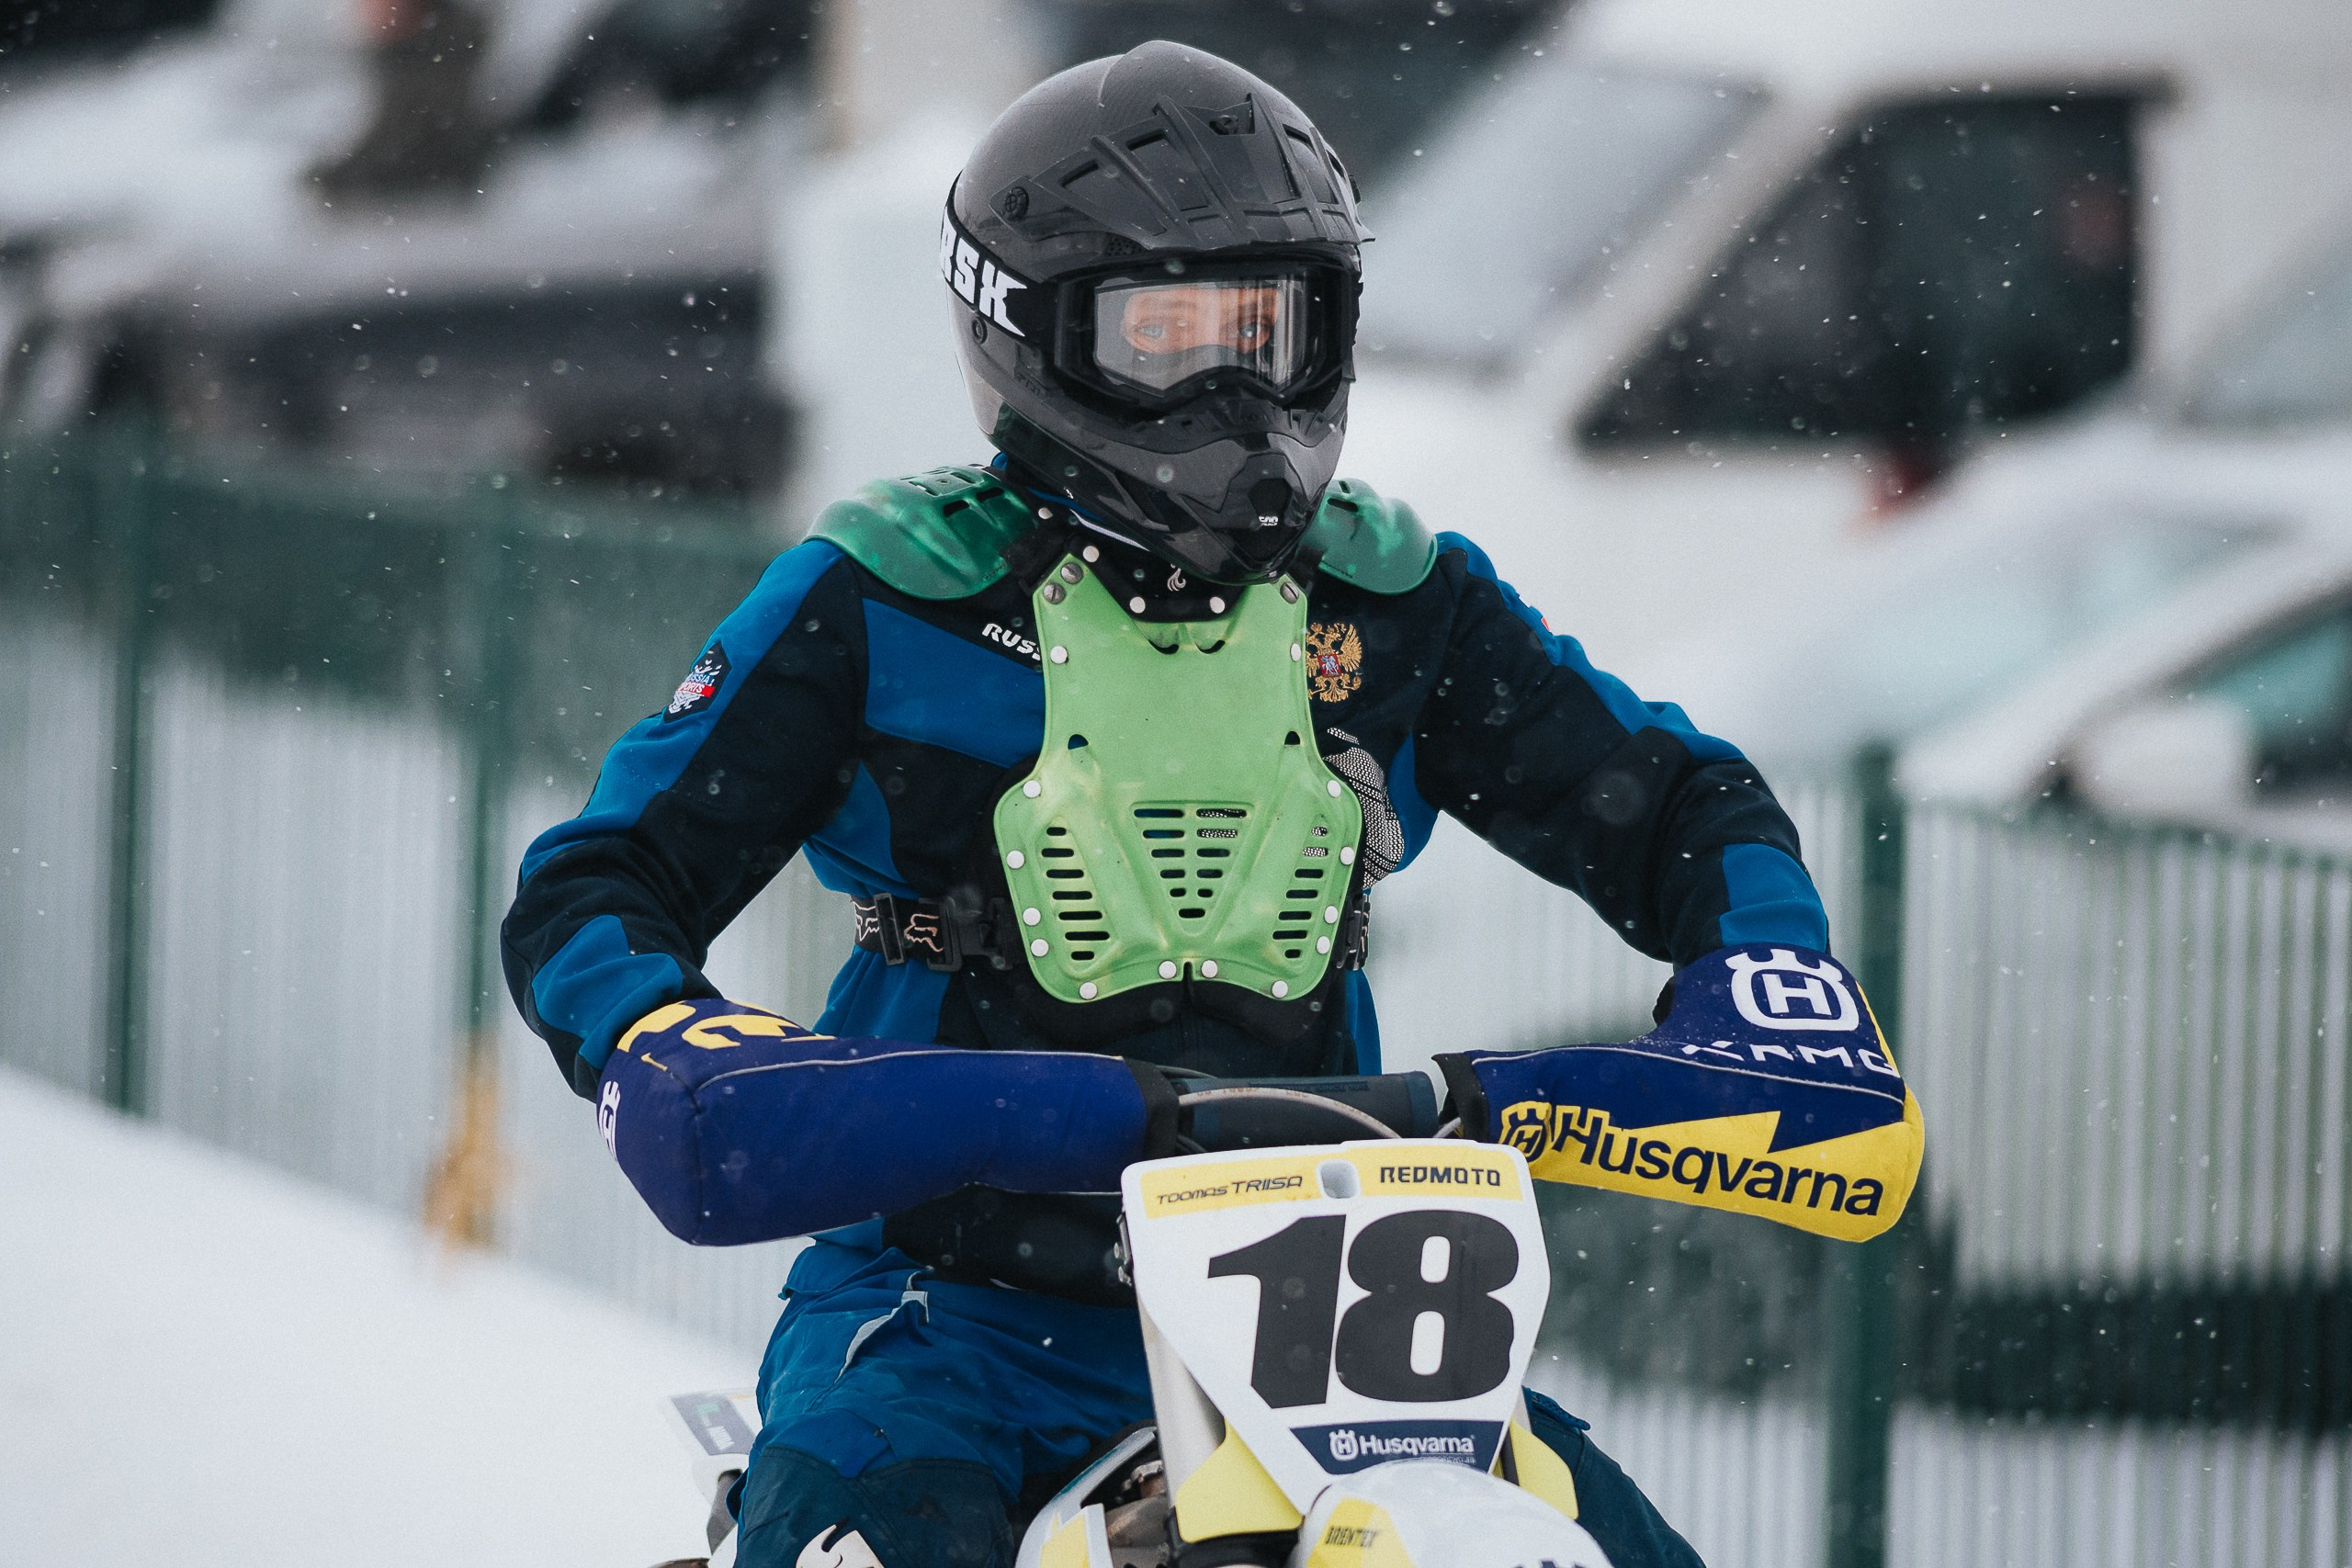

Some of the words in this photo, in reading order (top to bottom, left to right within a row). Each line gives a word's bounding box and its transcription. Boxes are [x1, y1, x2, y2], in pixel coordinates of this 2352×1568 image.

[1380, 1167, 1500, 1187] REDMOTO
[1554, 1111, 1884, 1216] Husqvarna
[1158, 1186, 1229, 1205] TOOMAS
[1231, 1176, 1303, 1194] TRIISA
[1207, 1209, 1519, 1409] 18
[1360, 1435, 1475, 1456] Husqvarna
